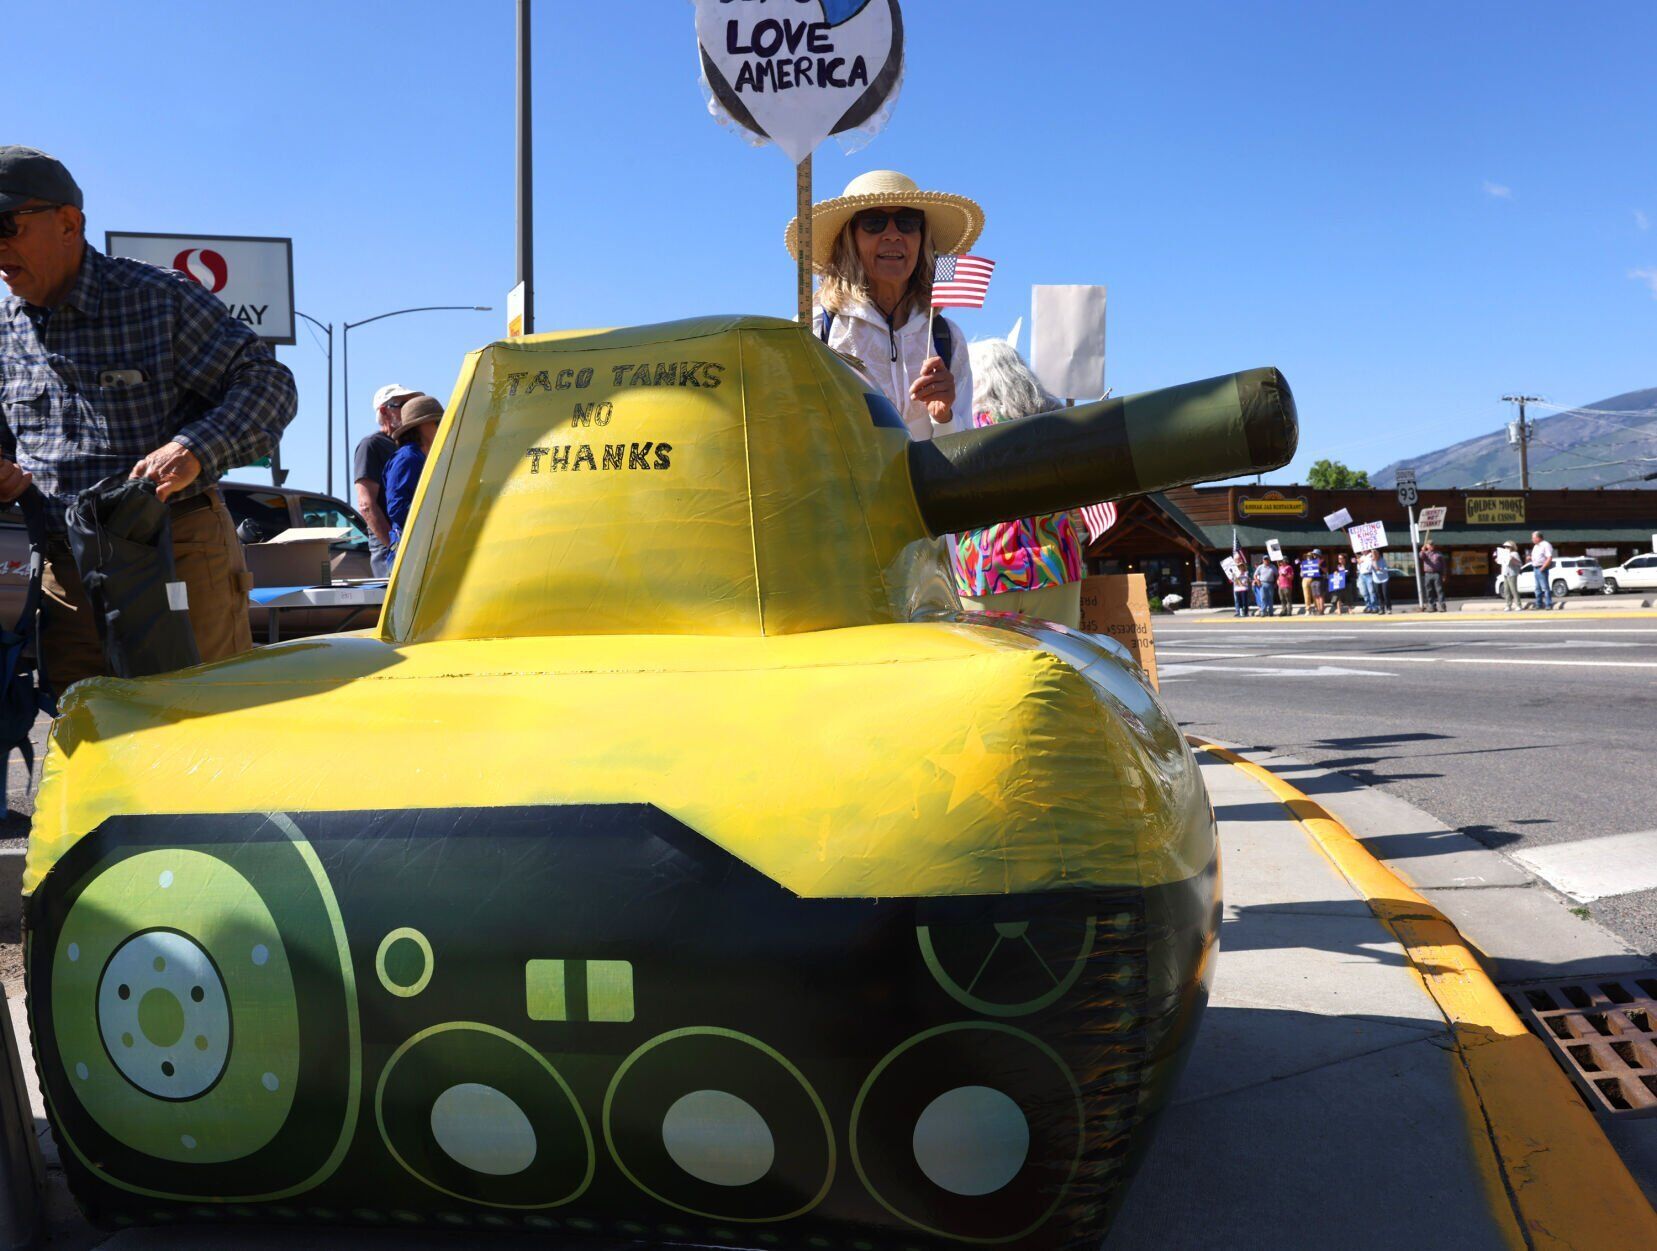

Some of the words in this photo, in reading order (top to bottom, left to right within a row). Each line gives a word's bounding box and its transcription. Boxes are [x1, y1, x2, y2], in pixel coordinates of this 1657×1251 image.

[727, 19, 834, 58] LOVE
[735, 55, 868, 93] AMERICA
[508, 367, 594, 396] TACO
[612, 361, 725, 388] TANKS
[571, 401, 613, 427] NO
[527, 441, 673, 474] THANKS
[1400, 487, 1415, 500] 93
[1467, 499, 1496, 517] GOLDEN
[1499, 499, 1523, 517] MOOSE
